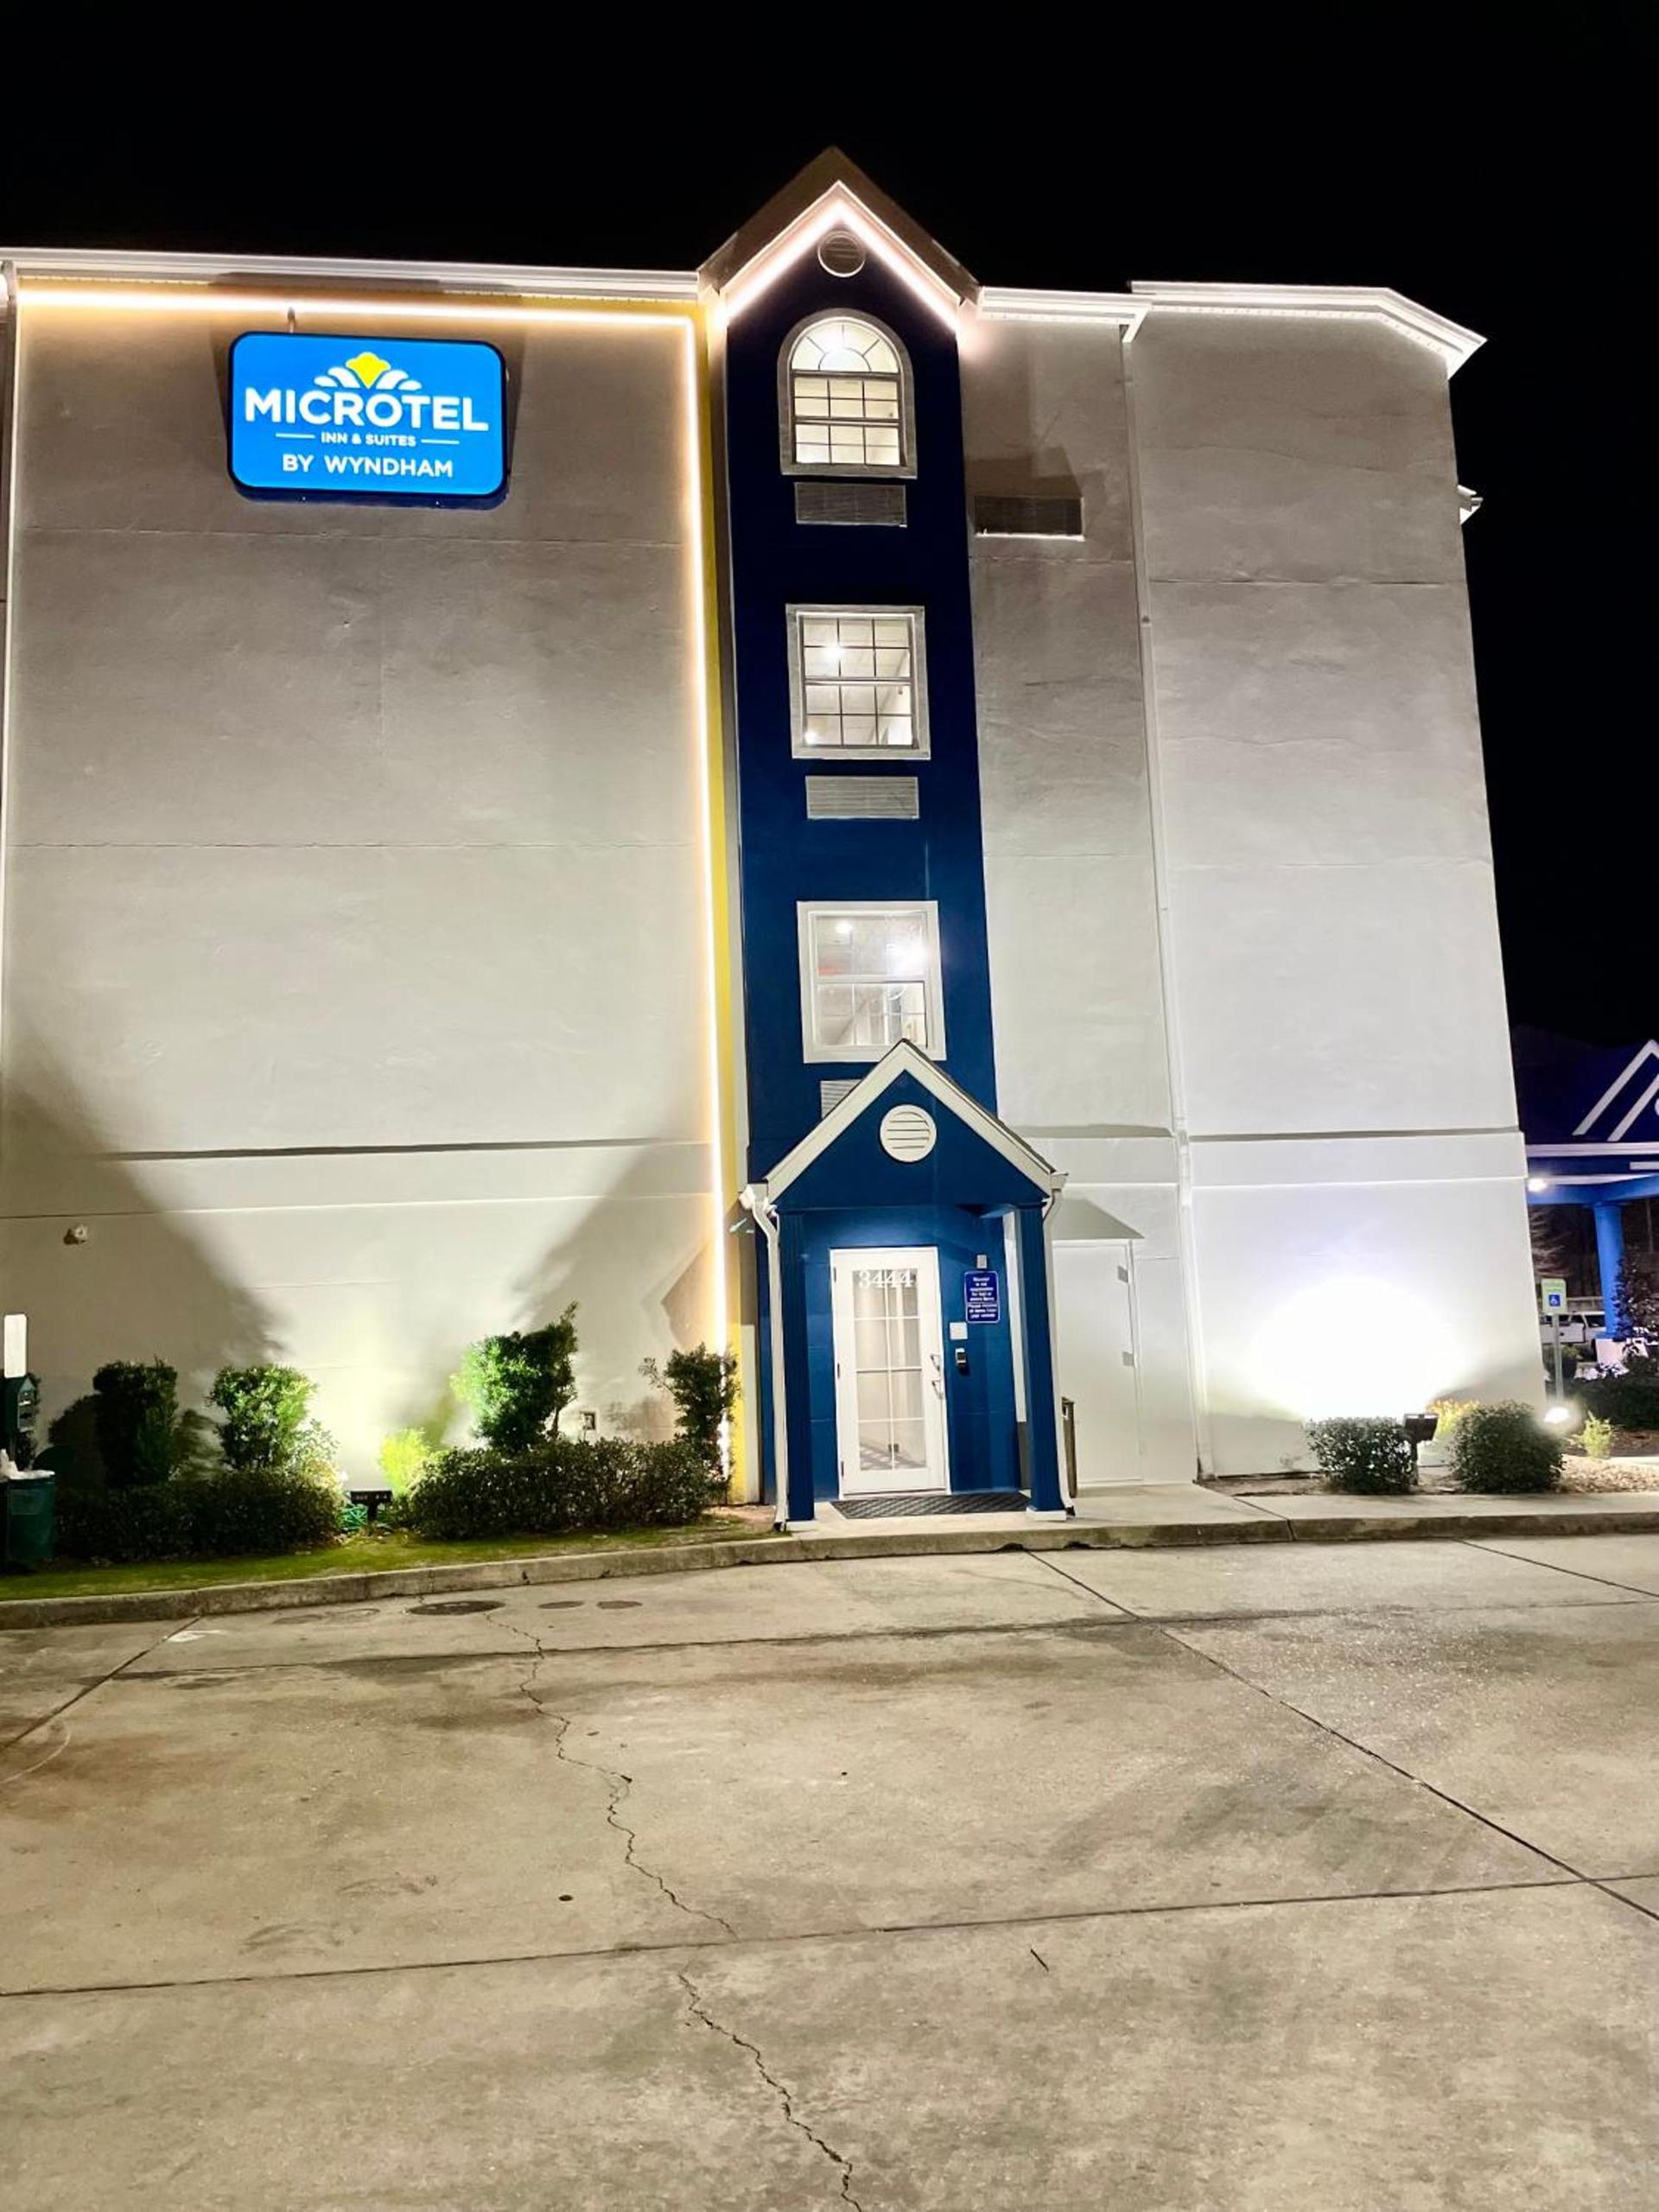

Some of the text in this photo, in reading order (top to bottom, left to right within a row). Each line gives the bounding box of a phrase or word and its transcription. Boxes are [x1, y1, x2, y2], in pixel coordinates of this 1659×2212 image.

[245, 387, 489, 431] MICROTEL
[321, 431, 416, 448] INN & SUITES
[282, 454, 454, 478] BY WYNDHAM
[858, 1269, 913, 1288] 3444
